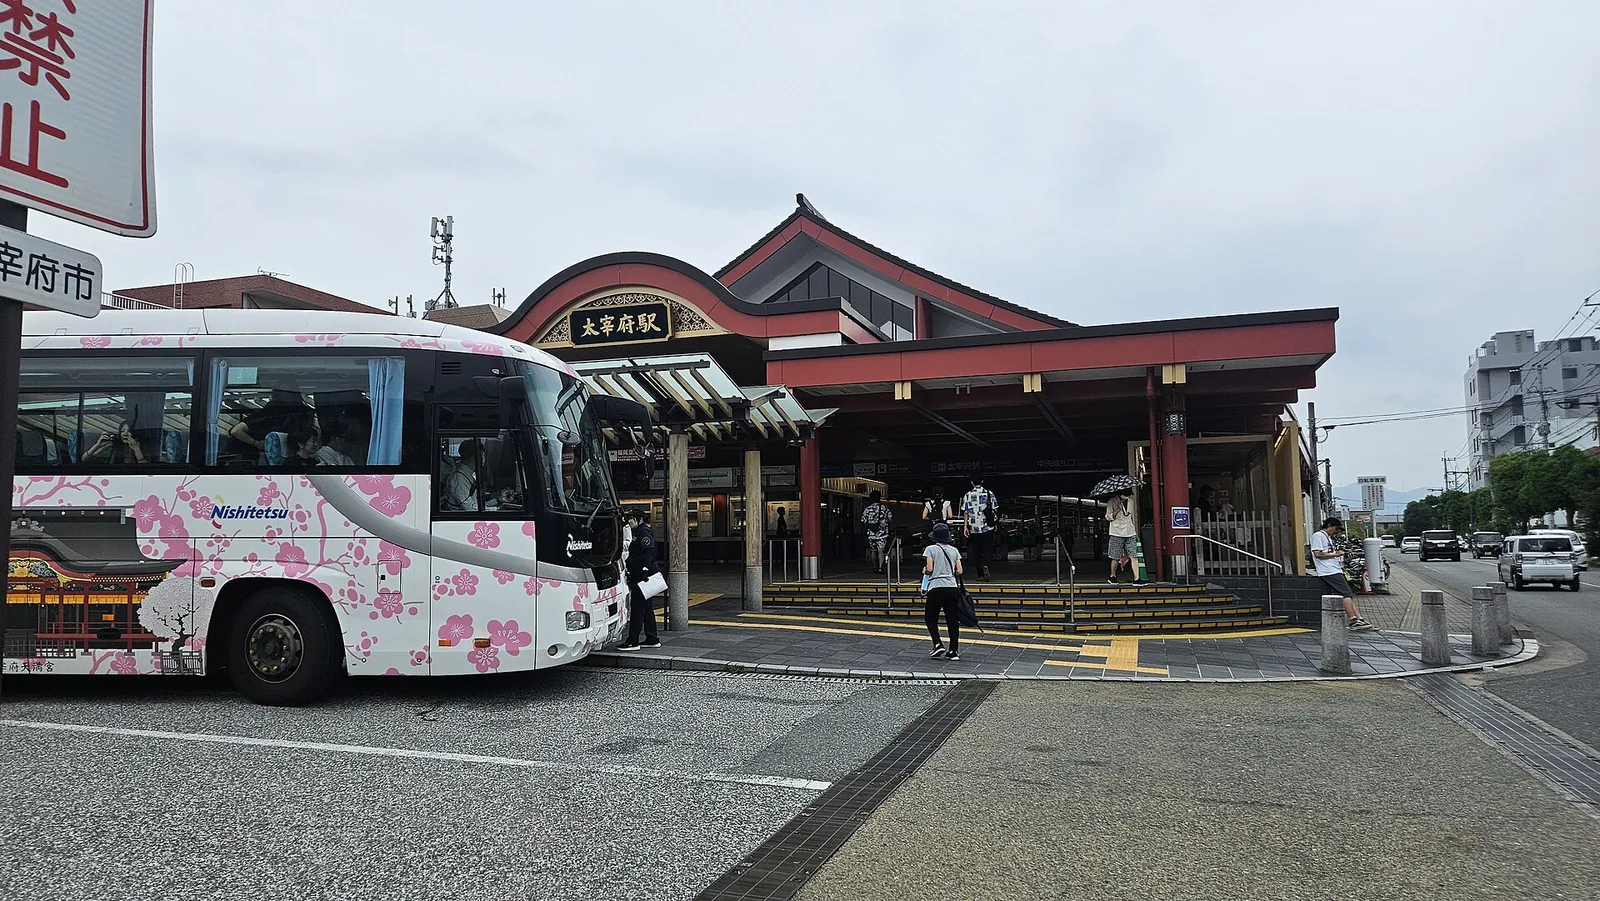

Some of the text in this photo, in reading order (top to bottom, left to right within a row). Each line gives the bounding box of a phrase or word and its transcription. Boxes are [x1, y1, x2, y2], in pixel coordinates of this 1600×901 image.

[0, 0, 76, 188] 禁止
[580, 312, 661, 337] 太宰府駅
[210, 505, 289, 519] Nishitetsu
